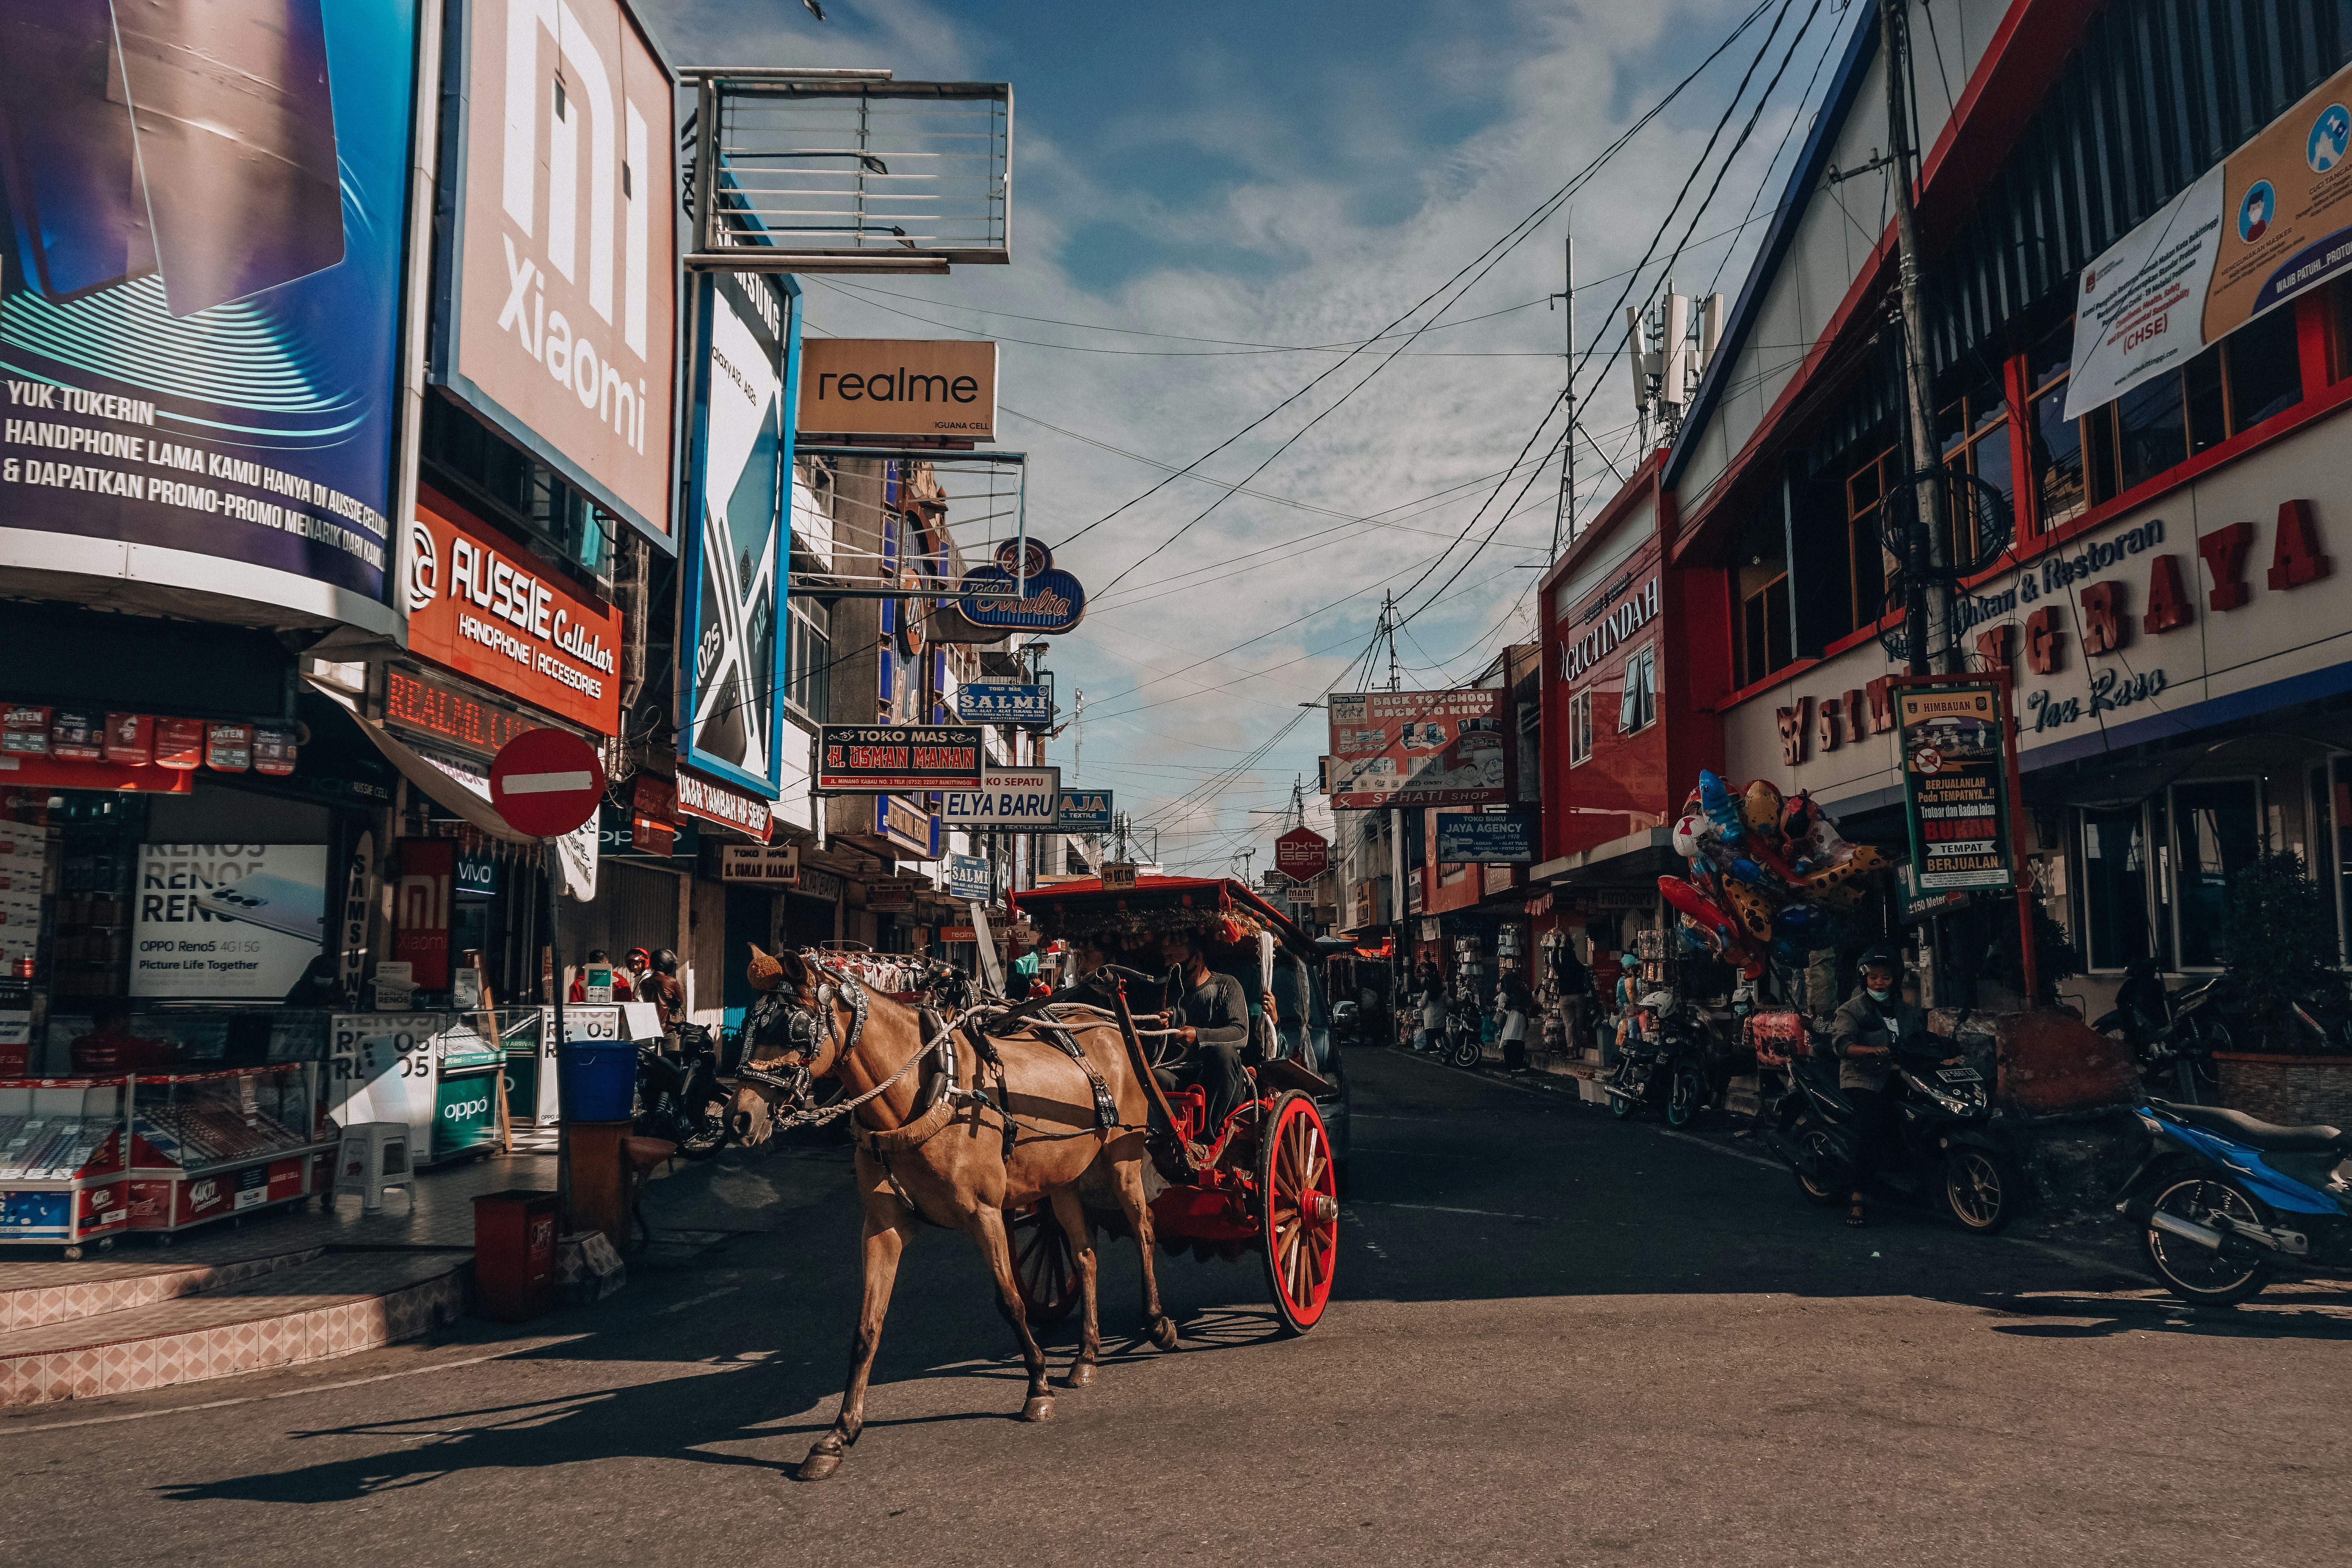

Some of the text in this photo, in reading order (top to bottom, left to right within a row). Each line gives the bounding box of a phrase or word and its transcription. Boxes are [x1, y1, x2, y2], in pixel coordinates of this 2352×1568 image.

[2309, 181, 2324, 195] CUCI
[2176, 240, 2188, 253] Kota
[2189, 214, 2219, 241] Bukittinggi
[2221, 227, 2292, 276] MENGGUNAKAN MASKER
[2276, 273, 2296, 293] WAJIB
[2124, 313, 2167, 355] (CHSE)
[497, 232, 646, 456] Xiaomi
[732, 365, 756, 407] A12 A02s
[819, 367, 978, 403] realme
[7, 379, 156, 426] YUK TUKERIN
[5, 419, 363, 524] HANDPHONE LAMA KAMU HANYA DI AUSSIE
[3, 458, 363, 558] & DAPATKAN PROMO-PROMO MENARIK DARI
[2021, 519, 2163, 603] & Restoran
[2081, 499, 2329, 657] RAYA
[451, 537, 614, 674] AUSSIE Cellular
[459, 613, 602, 699] HANDPHONE ACCESSORIES
[960, 695, 1047, 709] SALMI
[1373, 693, 1494, 706] BACK TO SCHOOL
[1924, 701, 1971, 712] HIMBAUAN
[3, 711, 43, 722] PATEN
[387, 673, 485, 745] REALME
[1374, 704, 1494, 717] BACK TO KIKY
[210, 730, 244, 739] PATEN
[857, 730, 947, 742] TOKO MAS
[827, 745, 975, 769] H. USMAN MANAN
[354, 782, 388, 799] AUSSIE CELL
[1004, 778, 1044, 786] SEPATU
[1926, 777, 1985, 790] BERJUALANLAH
[703, 783, 737, 824] TAMBAH
[737, 795, 747, 825] HP
[947, 794, 1054, 816] ELYA BARU
[1373, 791, 1489, 803] SEHATI SHOP
[1918, 791, 1938, 802] Pada
[1920, 803, 1996, 818] Trotoar dan Badan Jalan
[1446, 824, 1523, 833] JAYA AGENCY
[1924, 818, 1996, 840] BUKAN
[1279, 842, 1323, 851] OXY
[1941, 844, 1982, 853] TEMPAT
[458, 859, 492, 883] vivo
[735, 864, 762, 877] USMAN
[766, 864, 795, 878] MANAN
[1927, 855, 1998, 871] BERJUALAN
[952, 866, 989, 885] SALMI
[1125, 869, 1134, 881] 020
[1601, 892, 1624, 905] FOTO
[1926, 895, 1945, 908] Meter
[140, 940, 260, 953] OPPO Reno5 4G 5G
[397, 933, 448, 950] Xiaomi
[139, 960, 258, 972] Picture Life Together
[444, 1096, 488, 1122] oppo
[270, 1174, 286, 1183] AUSSIE
[287, 1171, 299, 1180] CELL
[195, 1194, 221, 1213] Unlimited
